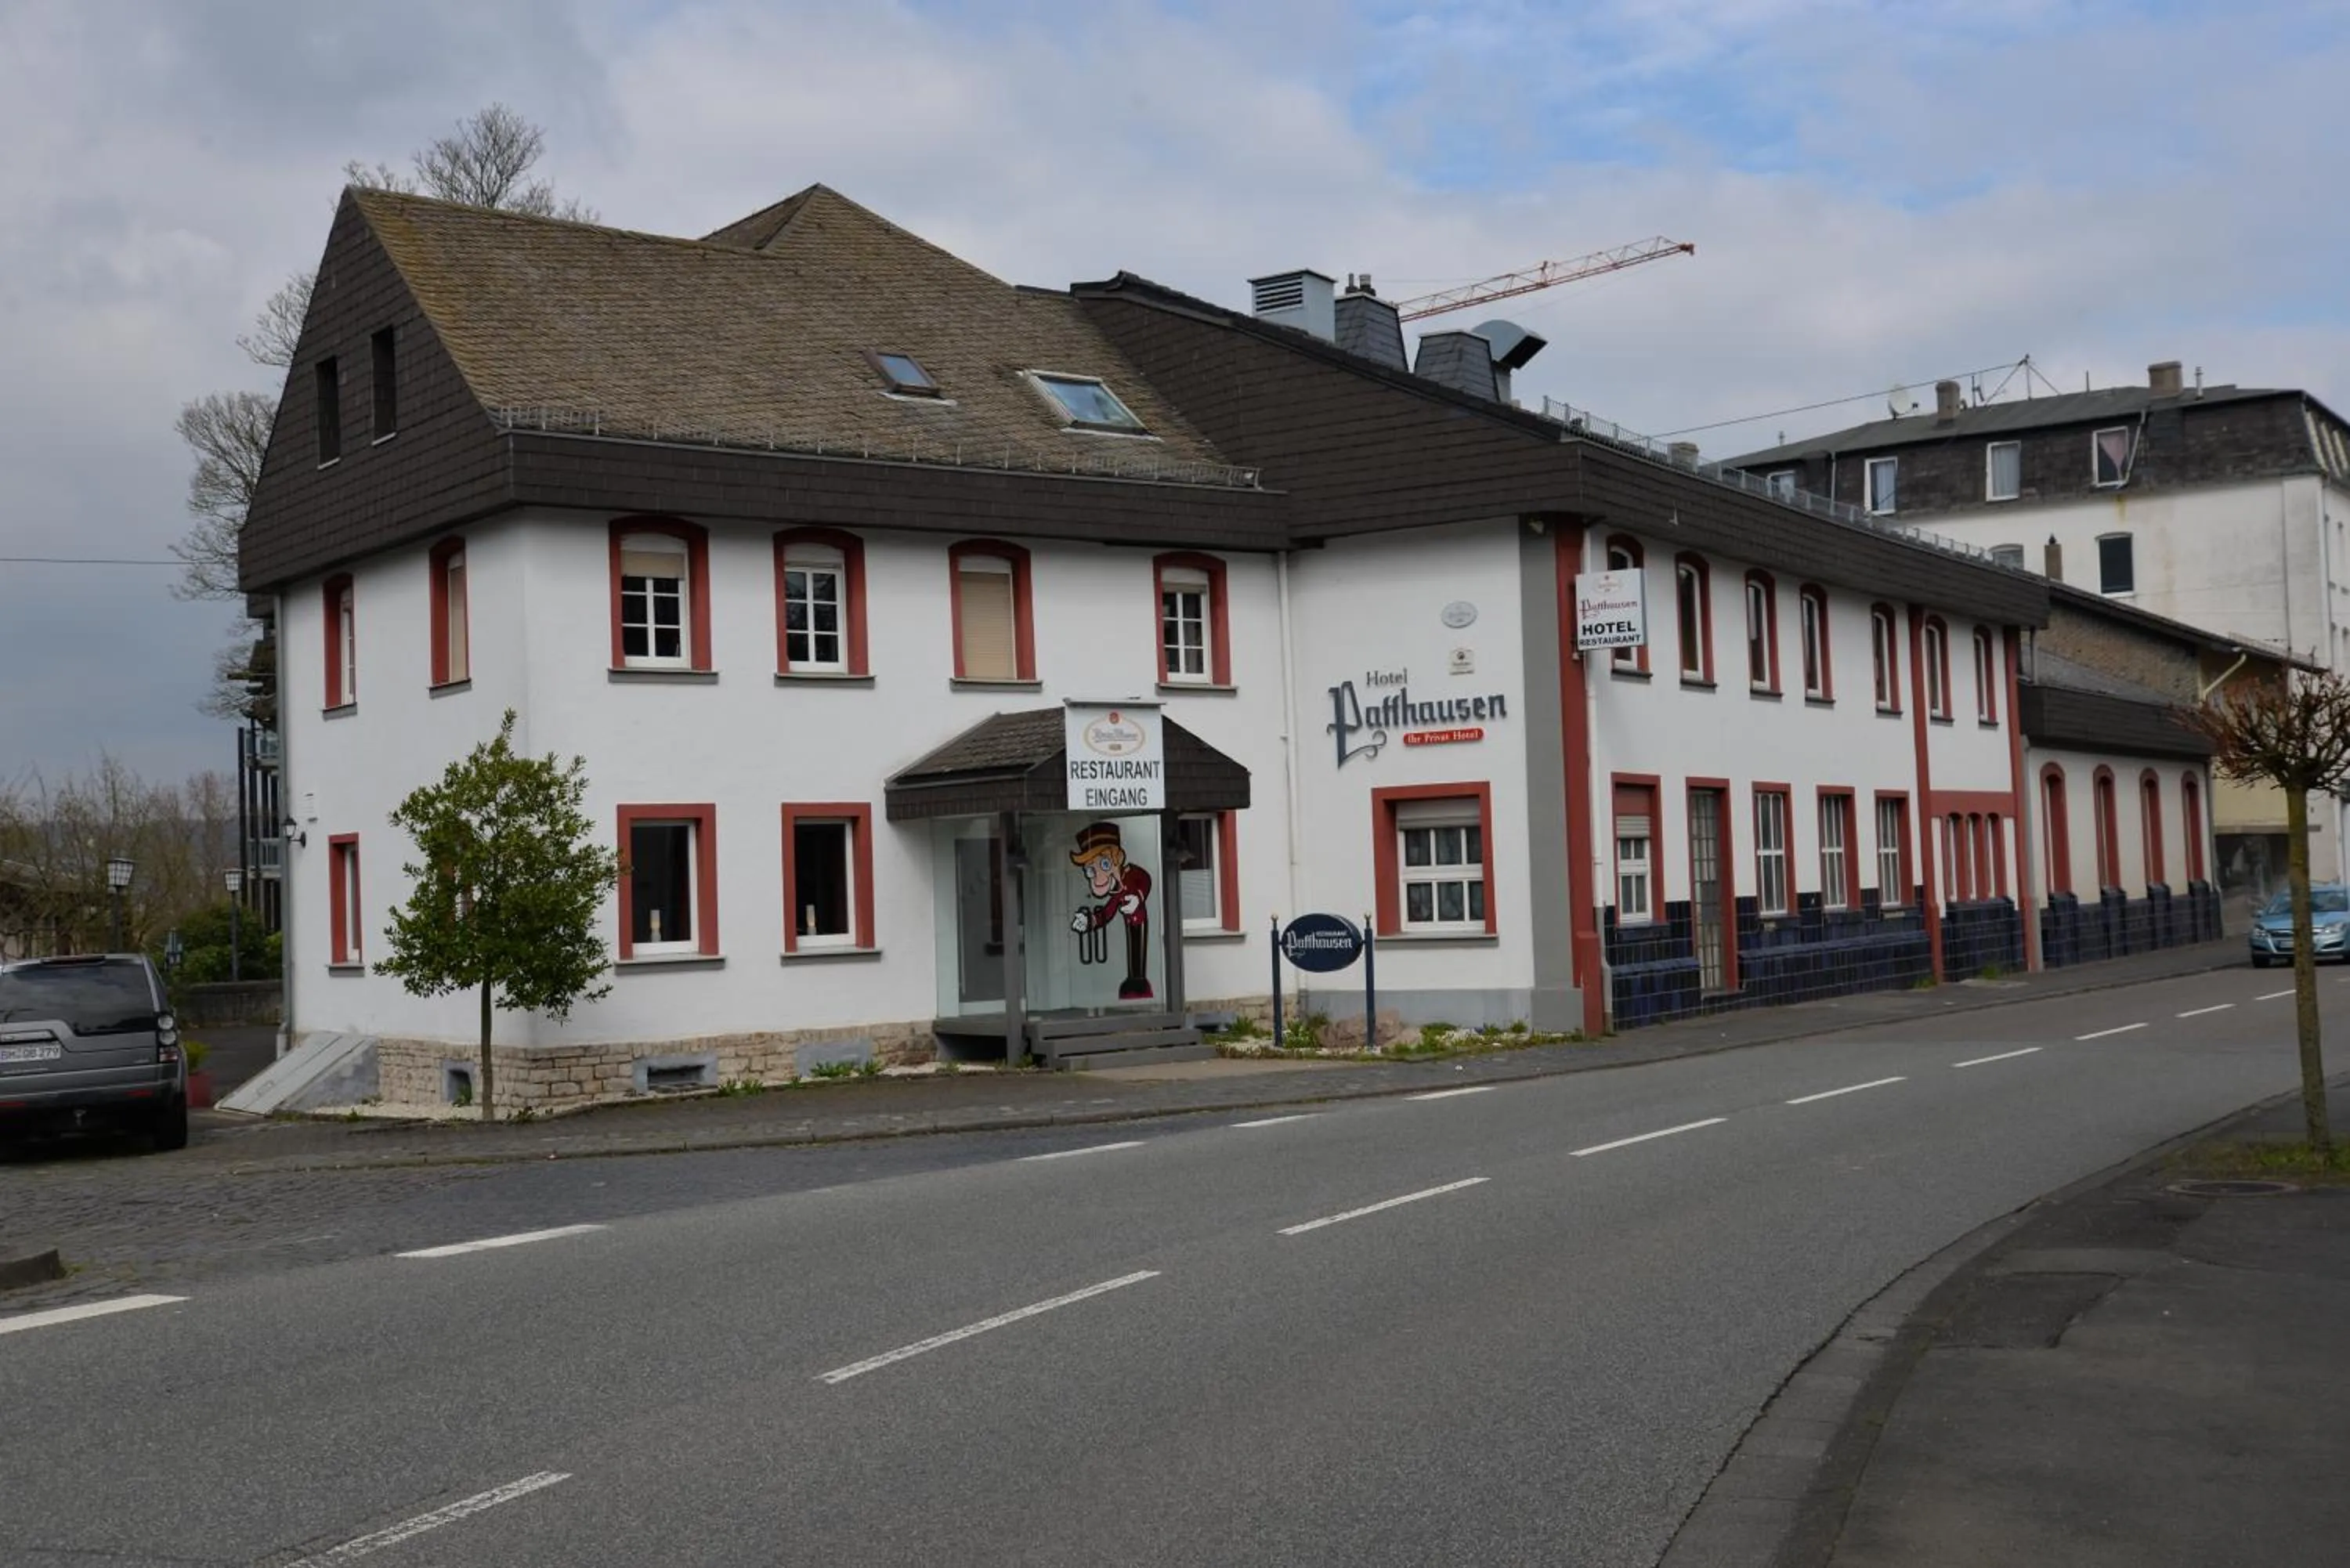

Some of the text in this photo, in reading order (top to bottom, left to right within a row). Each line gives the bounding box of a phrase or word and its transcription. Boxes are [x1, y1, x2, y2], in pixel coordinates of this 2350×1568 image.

[1582, 620, 1636, 635] HOTEL
[1579, 634, 1641, 645] RESTAURANT
[1366, 667, 1408, 686] Hotel
[1327, 681, 1507, 770] Paffhausen
[1453, 729, 1479, 740] Hotel
[1070, 761, 1160, 779] RESTAURANT
[1086, 788, 1148, 807] EINGANG
